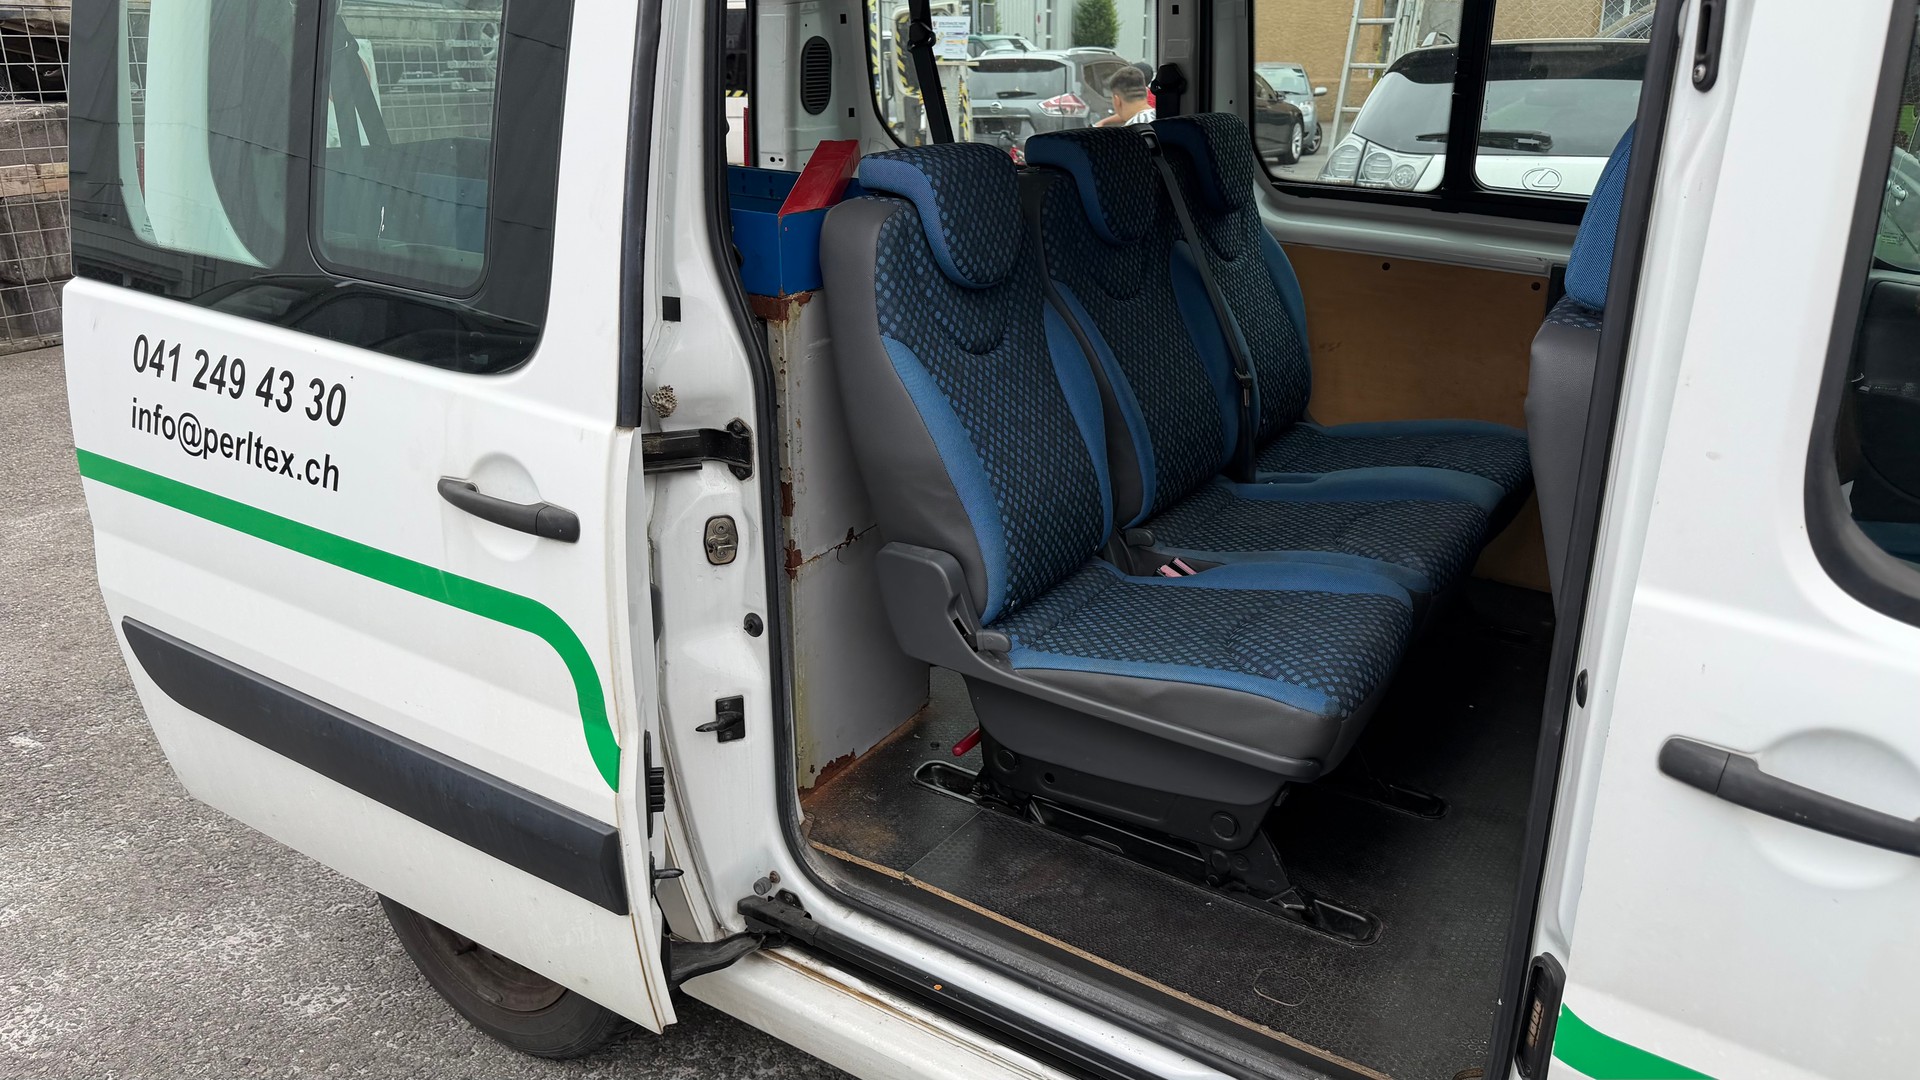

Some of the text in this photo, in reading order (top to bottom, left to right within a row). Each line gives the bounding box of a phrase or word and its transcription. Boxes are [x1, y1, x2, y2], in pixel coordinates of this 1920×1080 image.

[133, 334, 347, 427] 041 249 43 30
[131, 397, 339, 492] info@perltex.ch
